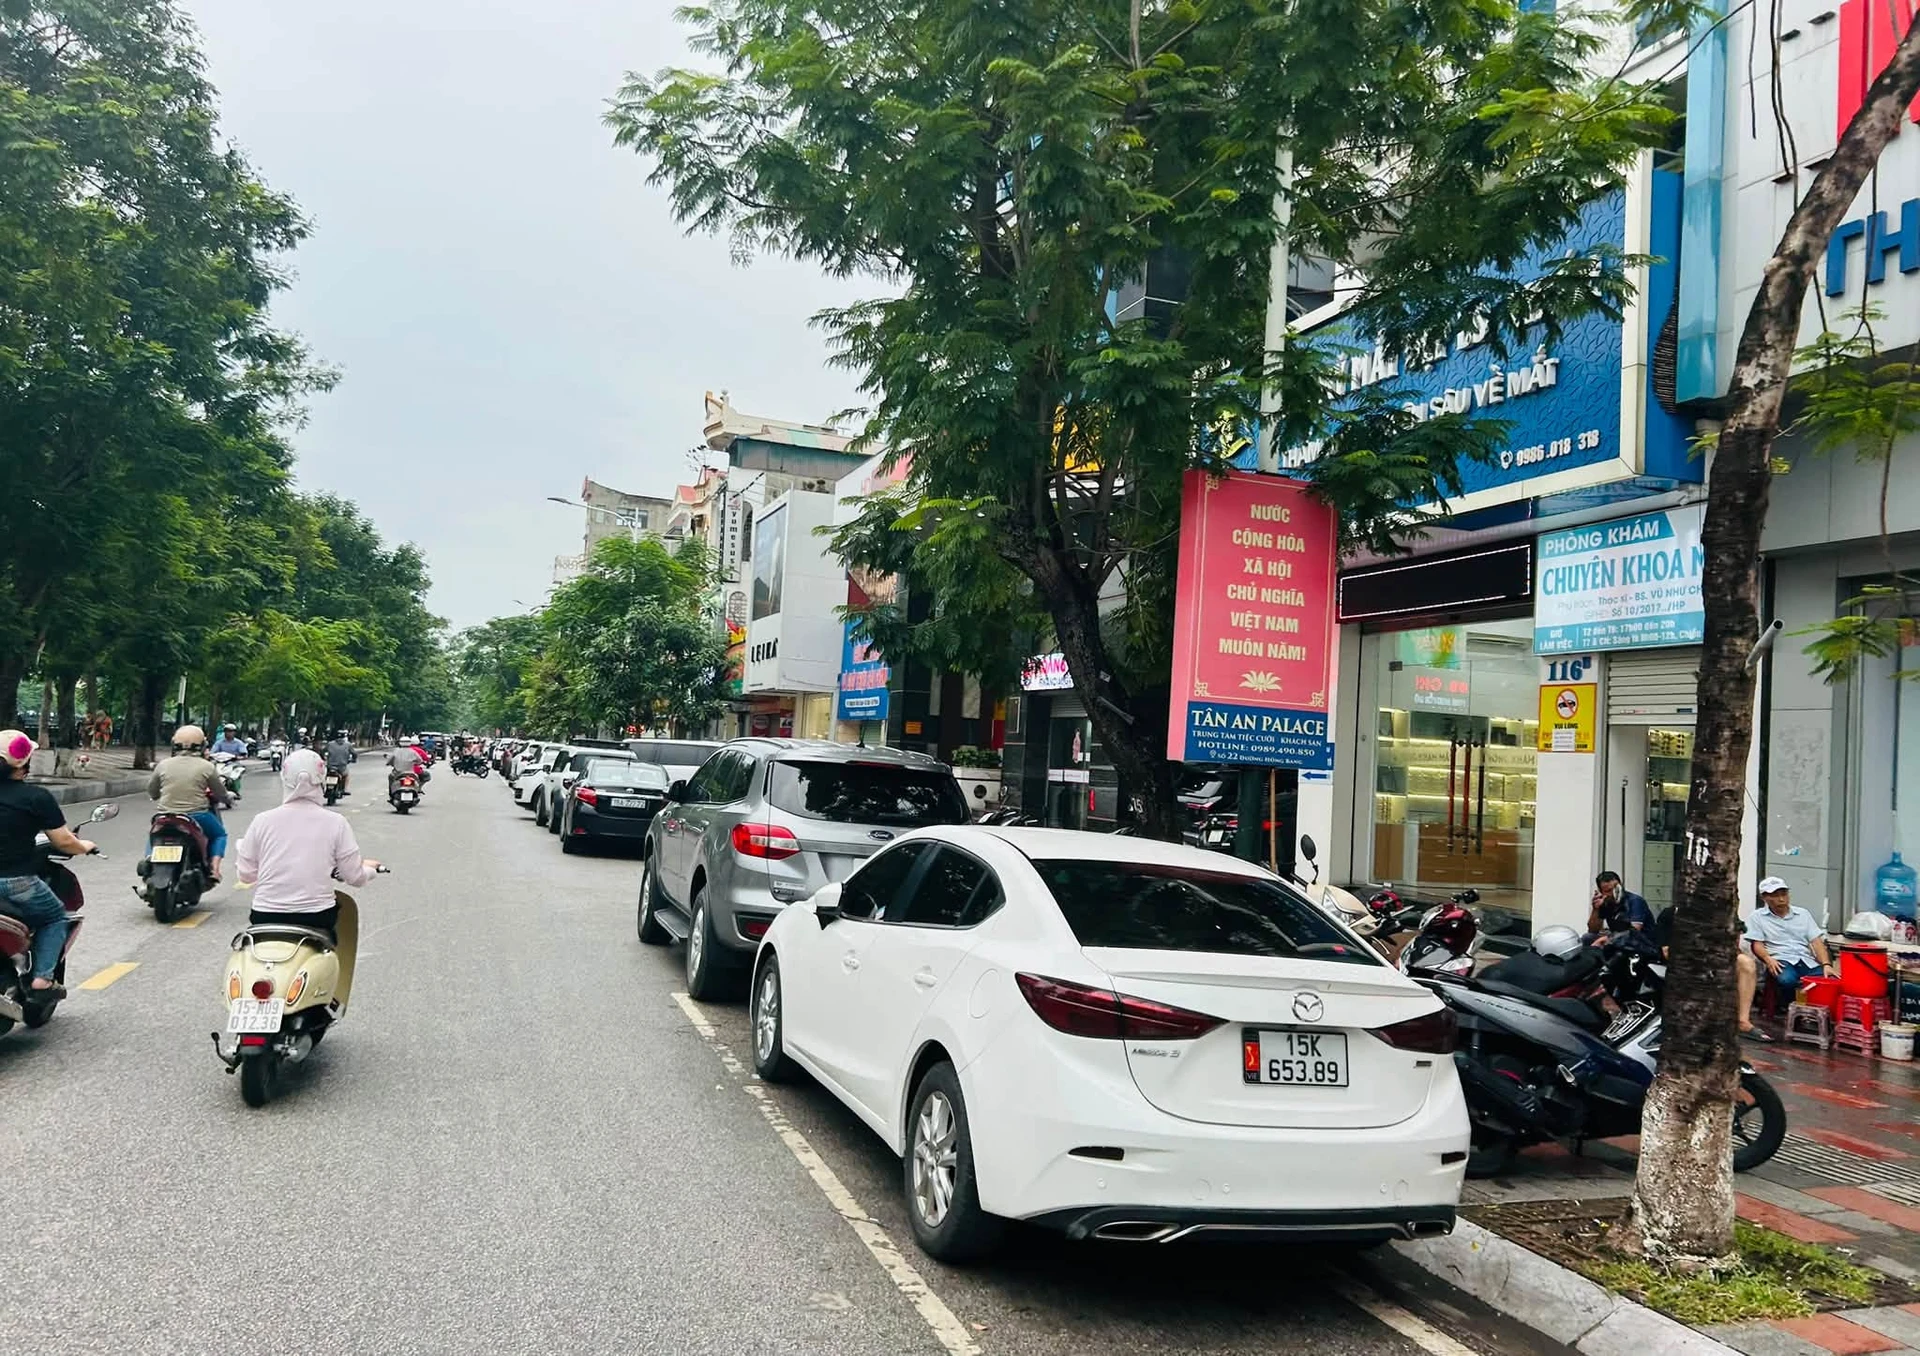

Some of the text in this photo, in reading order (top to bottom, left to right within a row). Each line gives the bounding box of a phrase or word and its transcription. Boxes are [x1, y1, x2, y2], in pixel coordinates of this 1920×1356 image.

[1474, 363, 1505, 408] VỀ
[1507, 343, 1560, 398] MẮT
[1250, 504, 1290, 523] NƯỚC
[1232, 527, 1305, 553] CỘNG HÒA
[1545, 518, 1660, 556] PHÒNG KHÁM
[1243, 557, 1292, 580] XÃ HỘI
[1542, 555, 1616, 596] CHUYÊN
[1621, 547, 1685, 586] KHOA
[1226, 581, 1305, 607] CHỦ NGHĨA
[1598, 596, 1618, 605] Thạc
[1635, 591, 1648, 600] BS.
[1651, 589, 1663, 599] VŨ
[1666, 587, 1687, 597] NHƯ
[1230, 610, 1299, 633] VIỆT NAM
[1611, 606, 1622, 617] Số
[1219, 637, 1306, 661] MUÔN NĂM!
[1191, 708, 1324, 736] TÂN AN PALACE
[1193, 730, 1219, 739] TRUNG
[1198, 740, 1249, 752] HOTLINE:
[1251, 745, 1315, 757] 0989.490.850
[1227, 752, 1238, 760] 22
[231, 1016, 277, 1030] 012.36
[1286, 1034, 1322, 1057] 15K
[1268, 1059, 1339, 1083] 653.89
